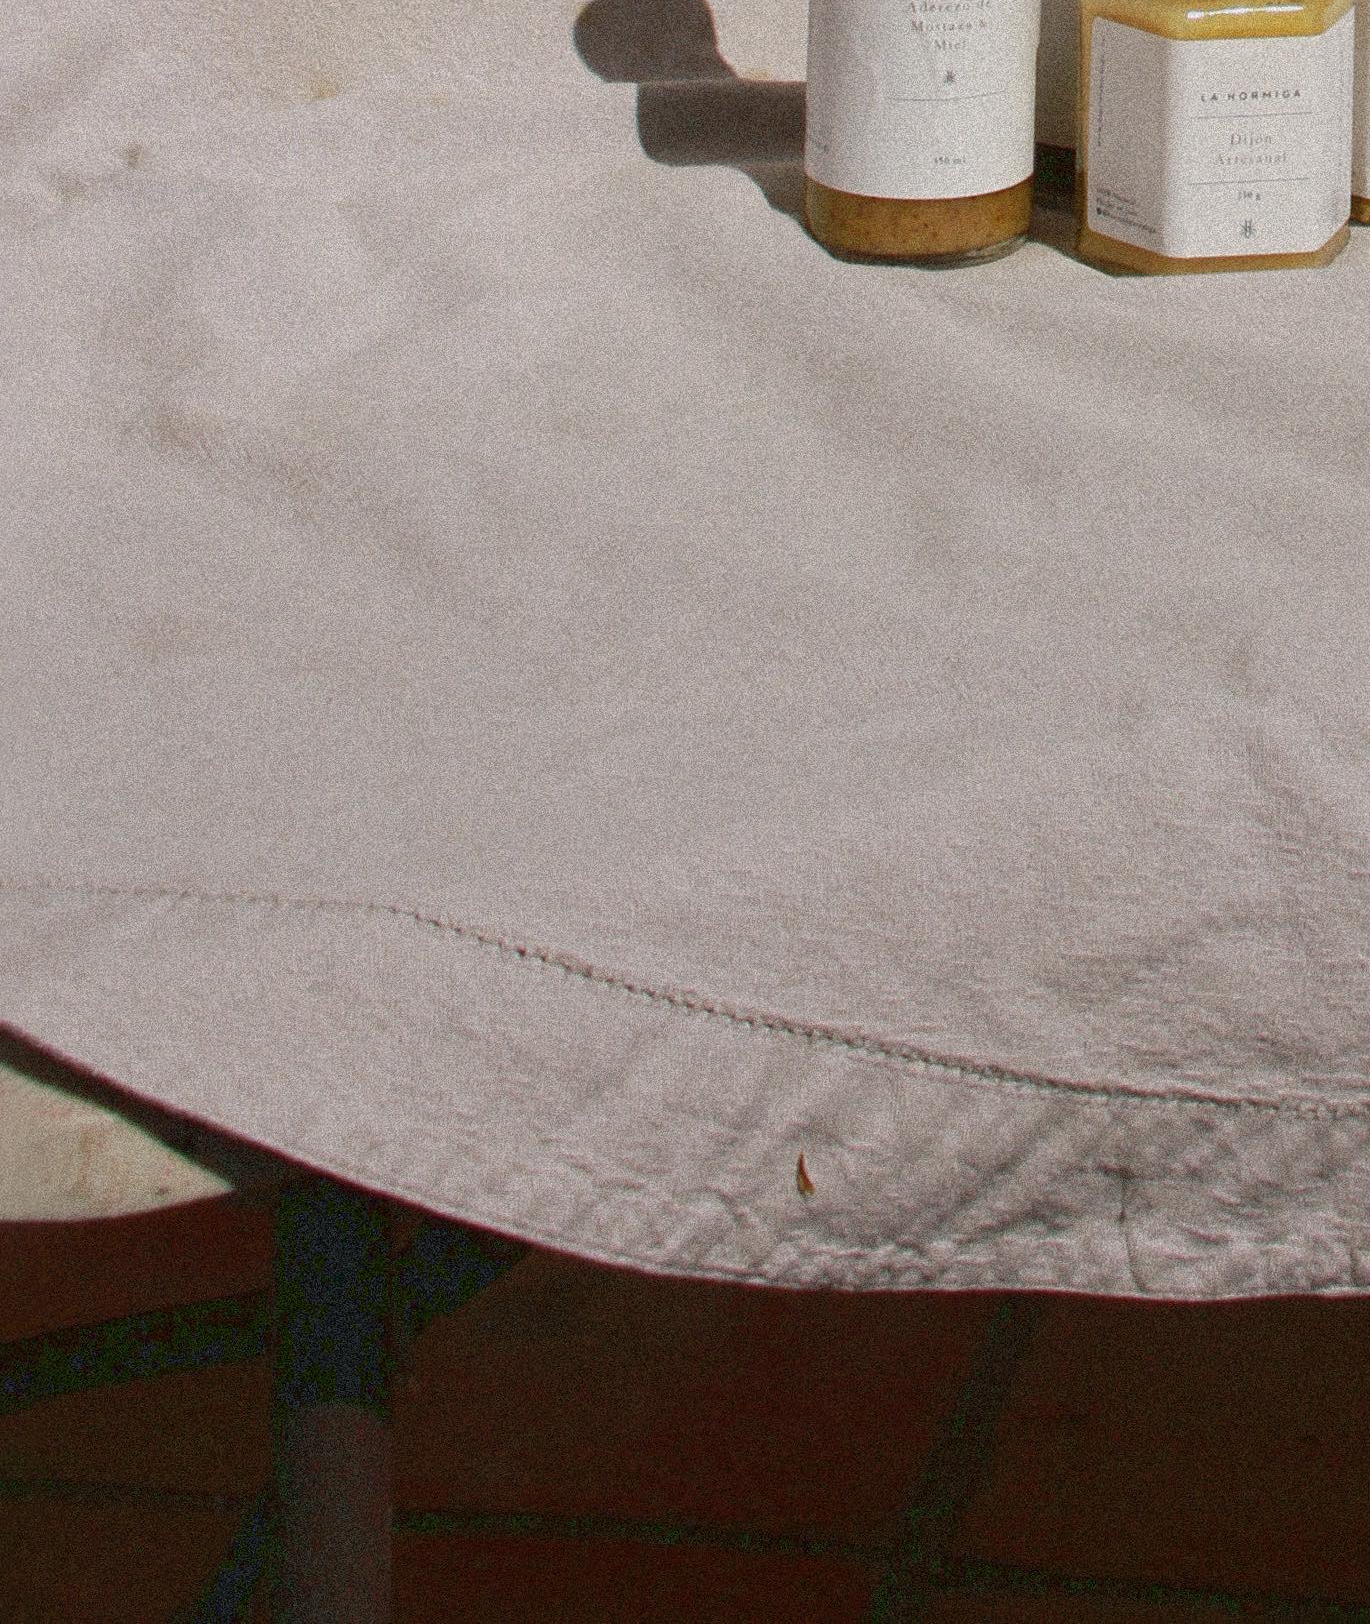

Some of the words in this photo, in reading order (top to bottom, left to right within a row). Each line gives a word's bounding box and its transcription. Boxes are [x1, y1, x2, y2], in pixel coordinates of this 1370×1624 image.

[908, 0, 971, 14] Aderezo
[934, 39, 967, 51] Miel
[1200, 92, 1218, 103] LA
[1227, 88, 1301, 102] HORMIGA
